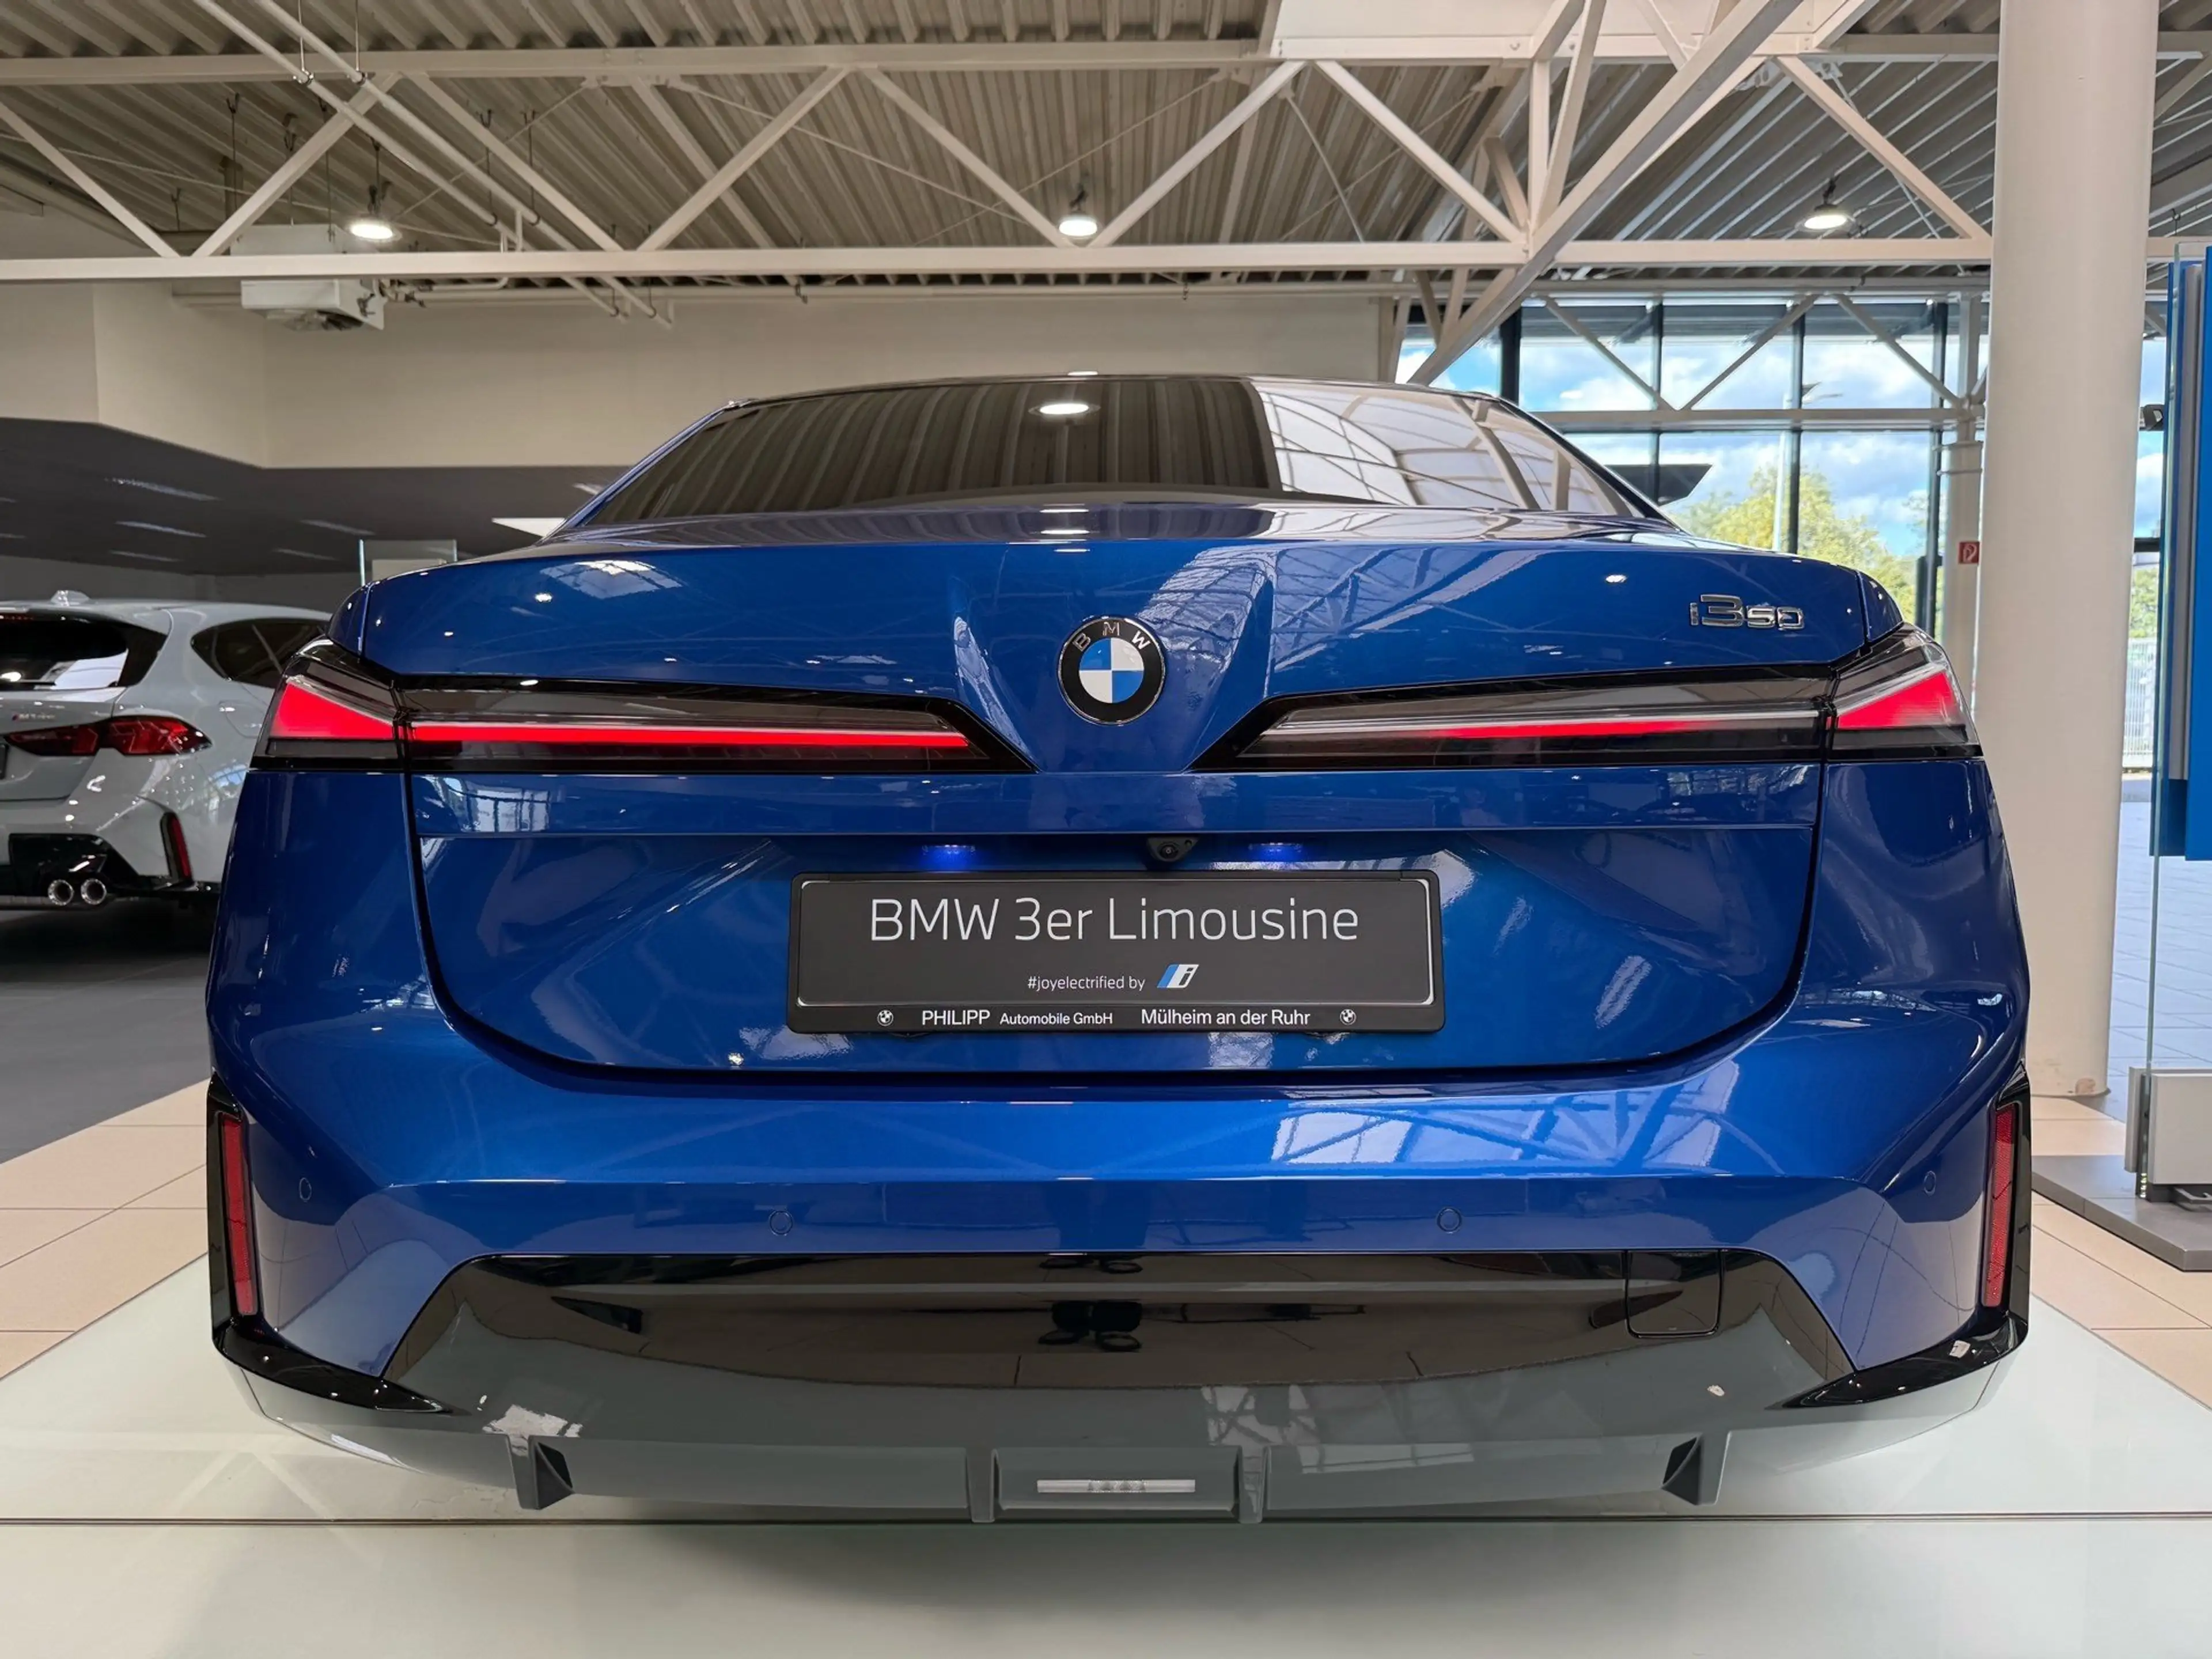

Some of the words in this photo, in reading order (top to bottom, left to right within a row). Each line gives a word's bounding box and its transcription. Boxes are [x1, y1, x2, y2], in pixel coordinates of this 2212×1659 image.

[1072, 622, 1151, 652] BMW
[871, 898, 999, 941] BMW
[1014, 897, 1093, 941] 3er
[1109, 897, 1358, 941] Limousine
[1027, 975, 1124, 992] #joyelectrified
[1128, 975, 1146, 991] by
[922, 1009, 991, 1025] PHILIPP
[999, 1012, 1070, 1025] Automobile
[1073, 1012, 1113, 1025] GmbH
[1141, 1009, 1212, 1025] Mülheim
[1216, 1012, 1236, 1025] an
[1240, 1009, 1268, 1025] der
[1271, 1009, 1311, 1025] Ruhr
